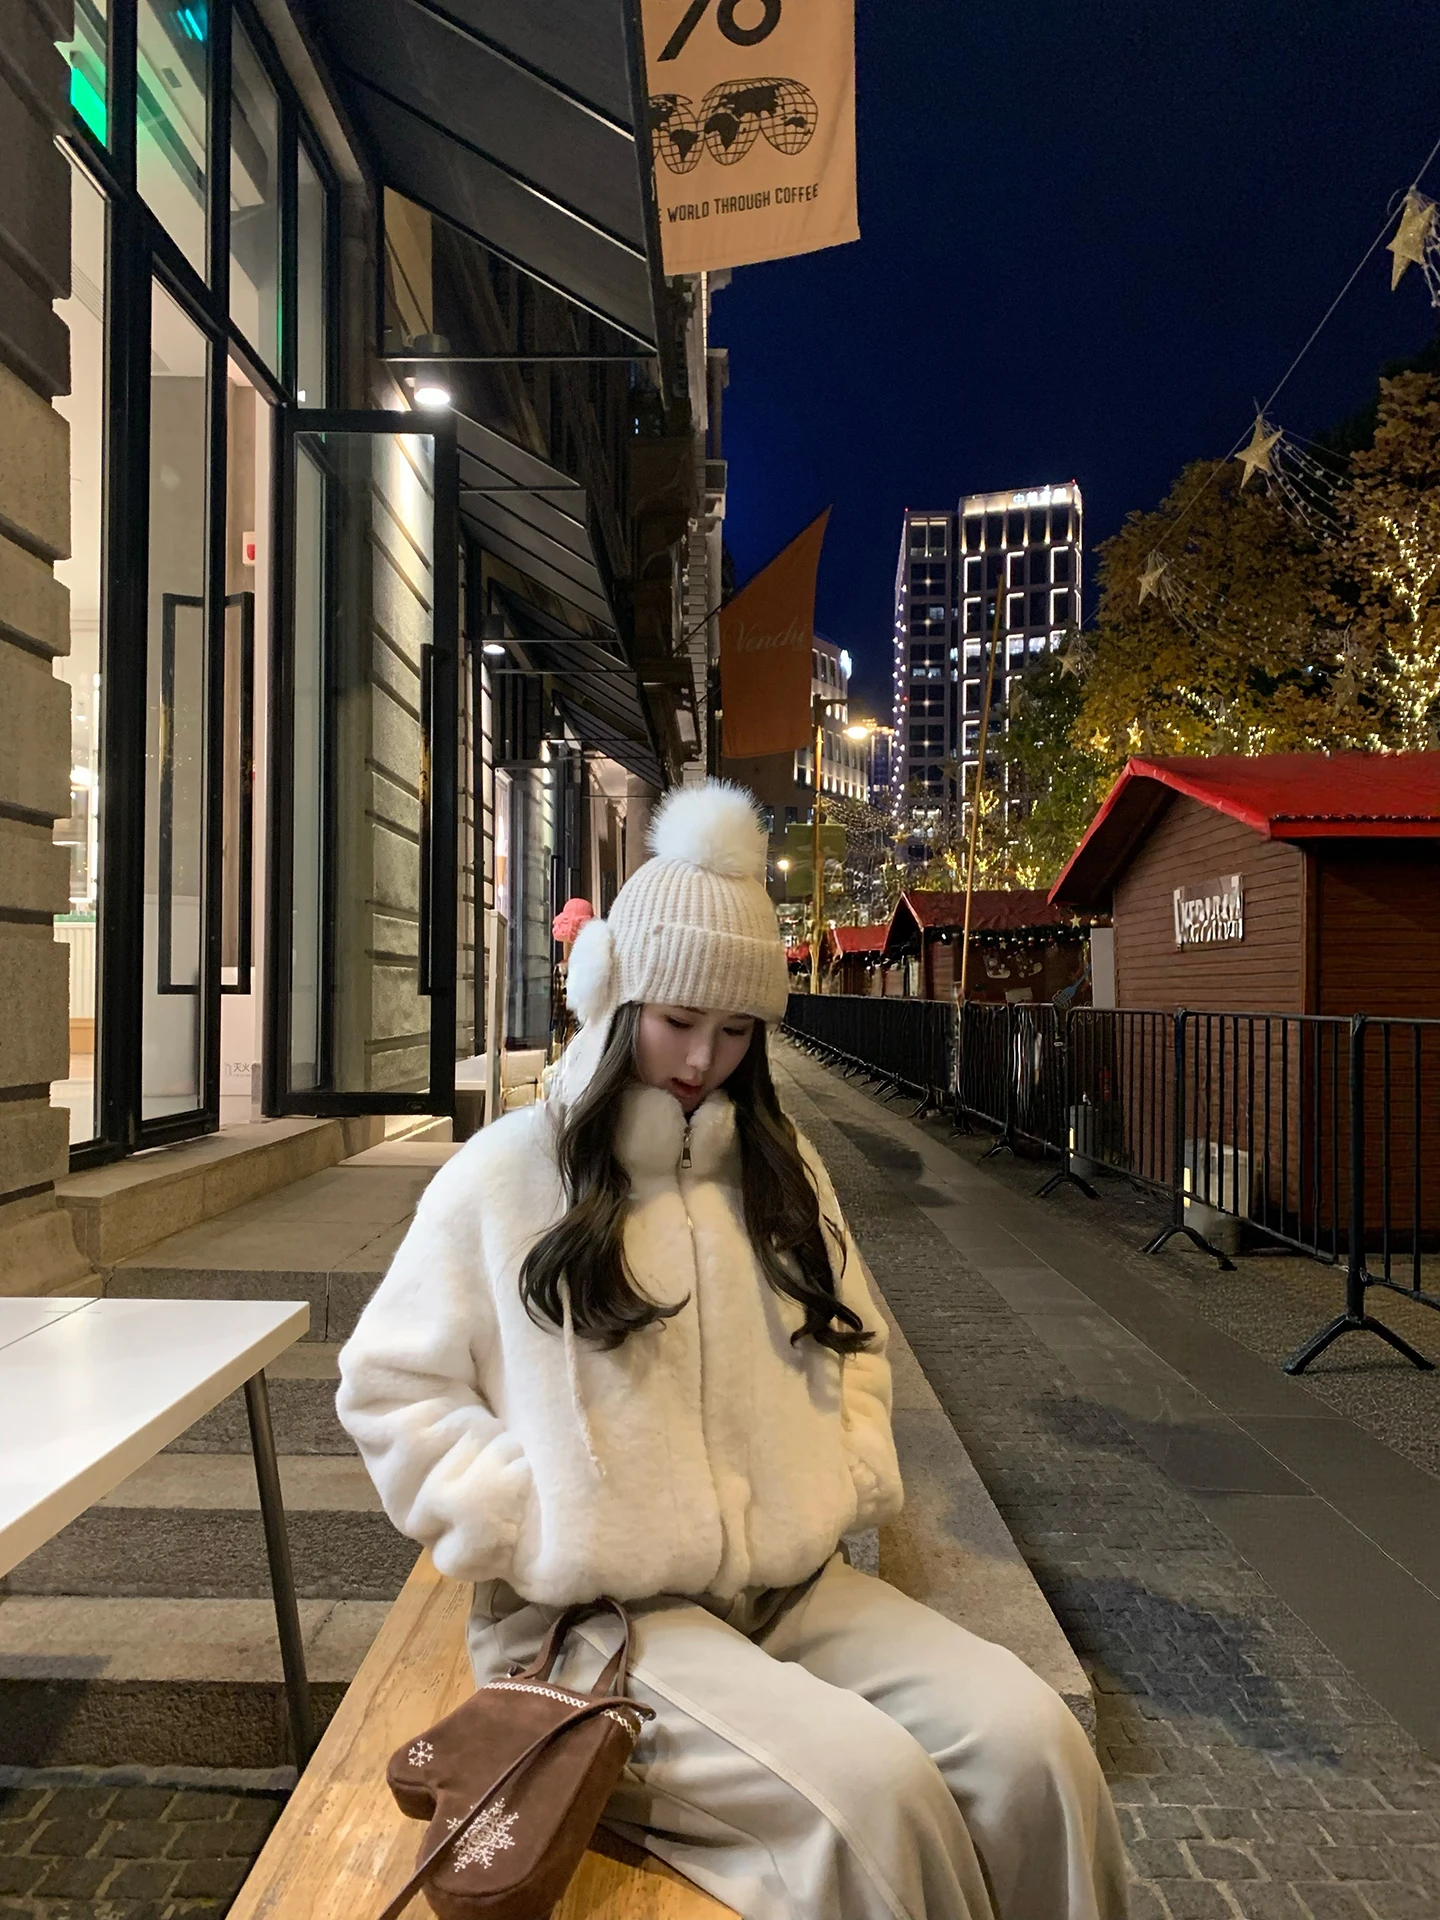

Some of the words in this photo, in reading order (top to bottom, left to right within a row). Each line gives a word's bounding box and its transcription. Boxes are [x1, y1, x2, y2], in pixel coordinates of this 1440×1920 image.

[667, 201, 710, 223] WORLD
[713, 190, 771, 215] THROUGH
[775, 183, 819, 204] COFFEE
[723, 615, 806, 653] Venchi
